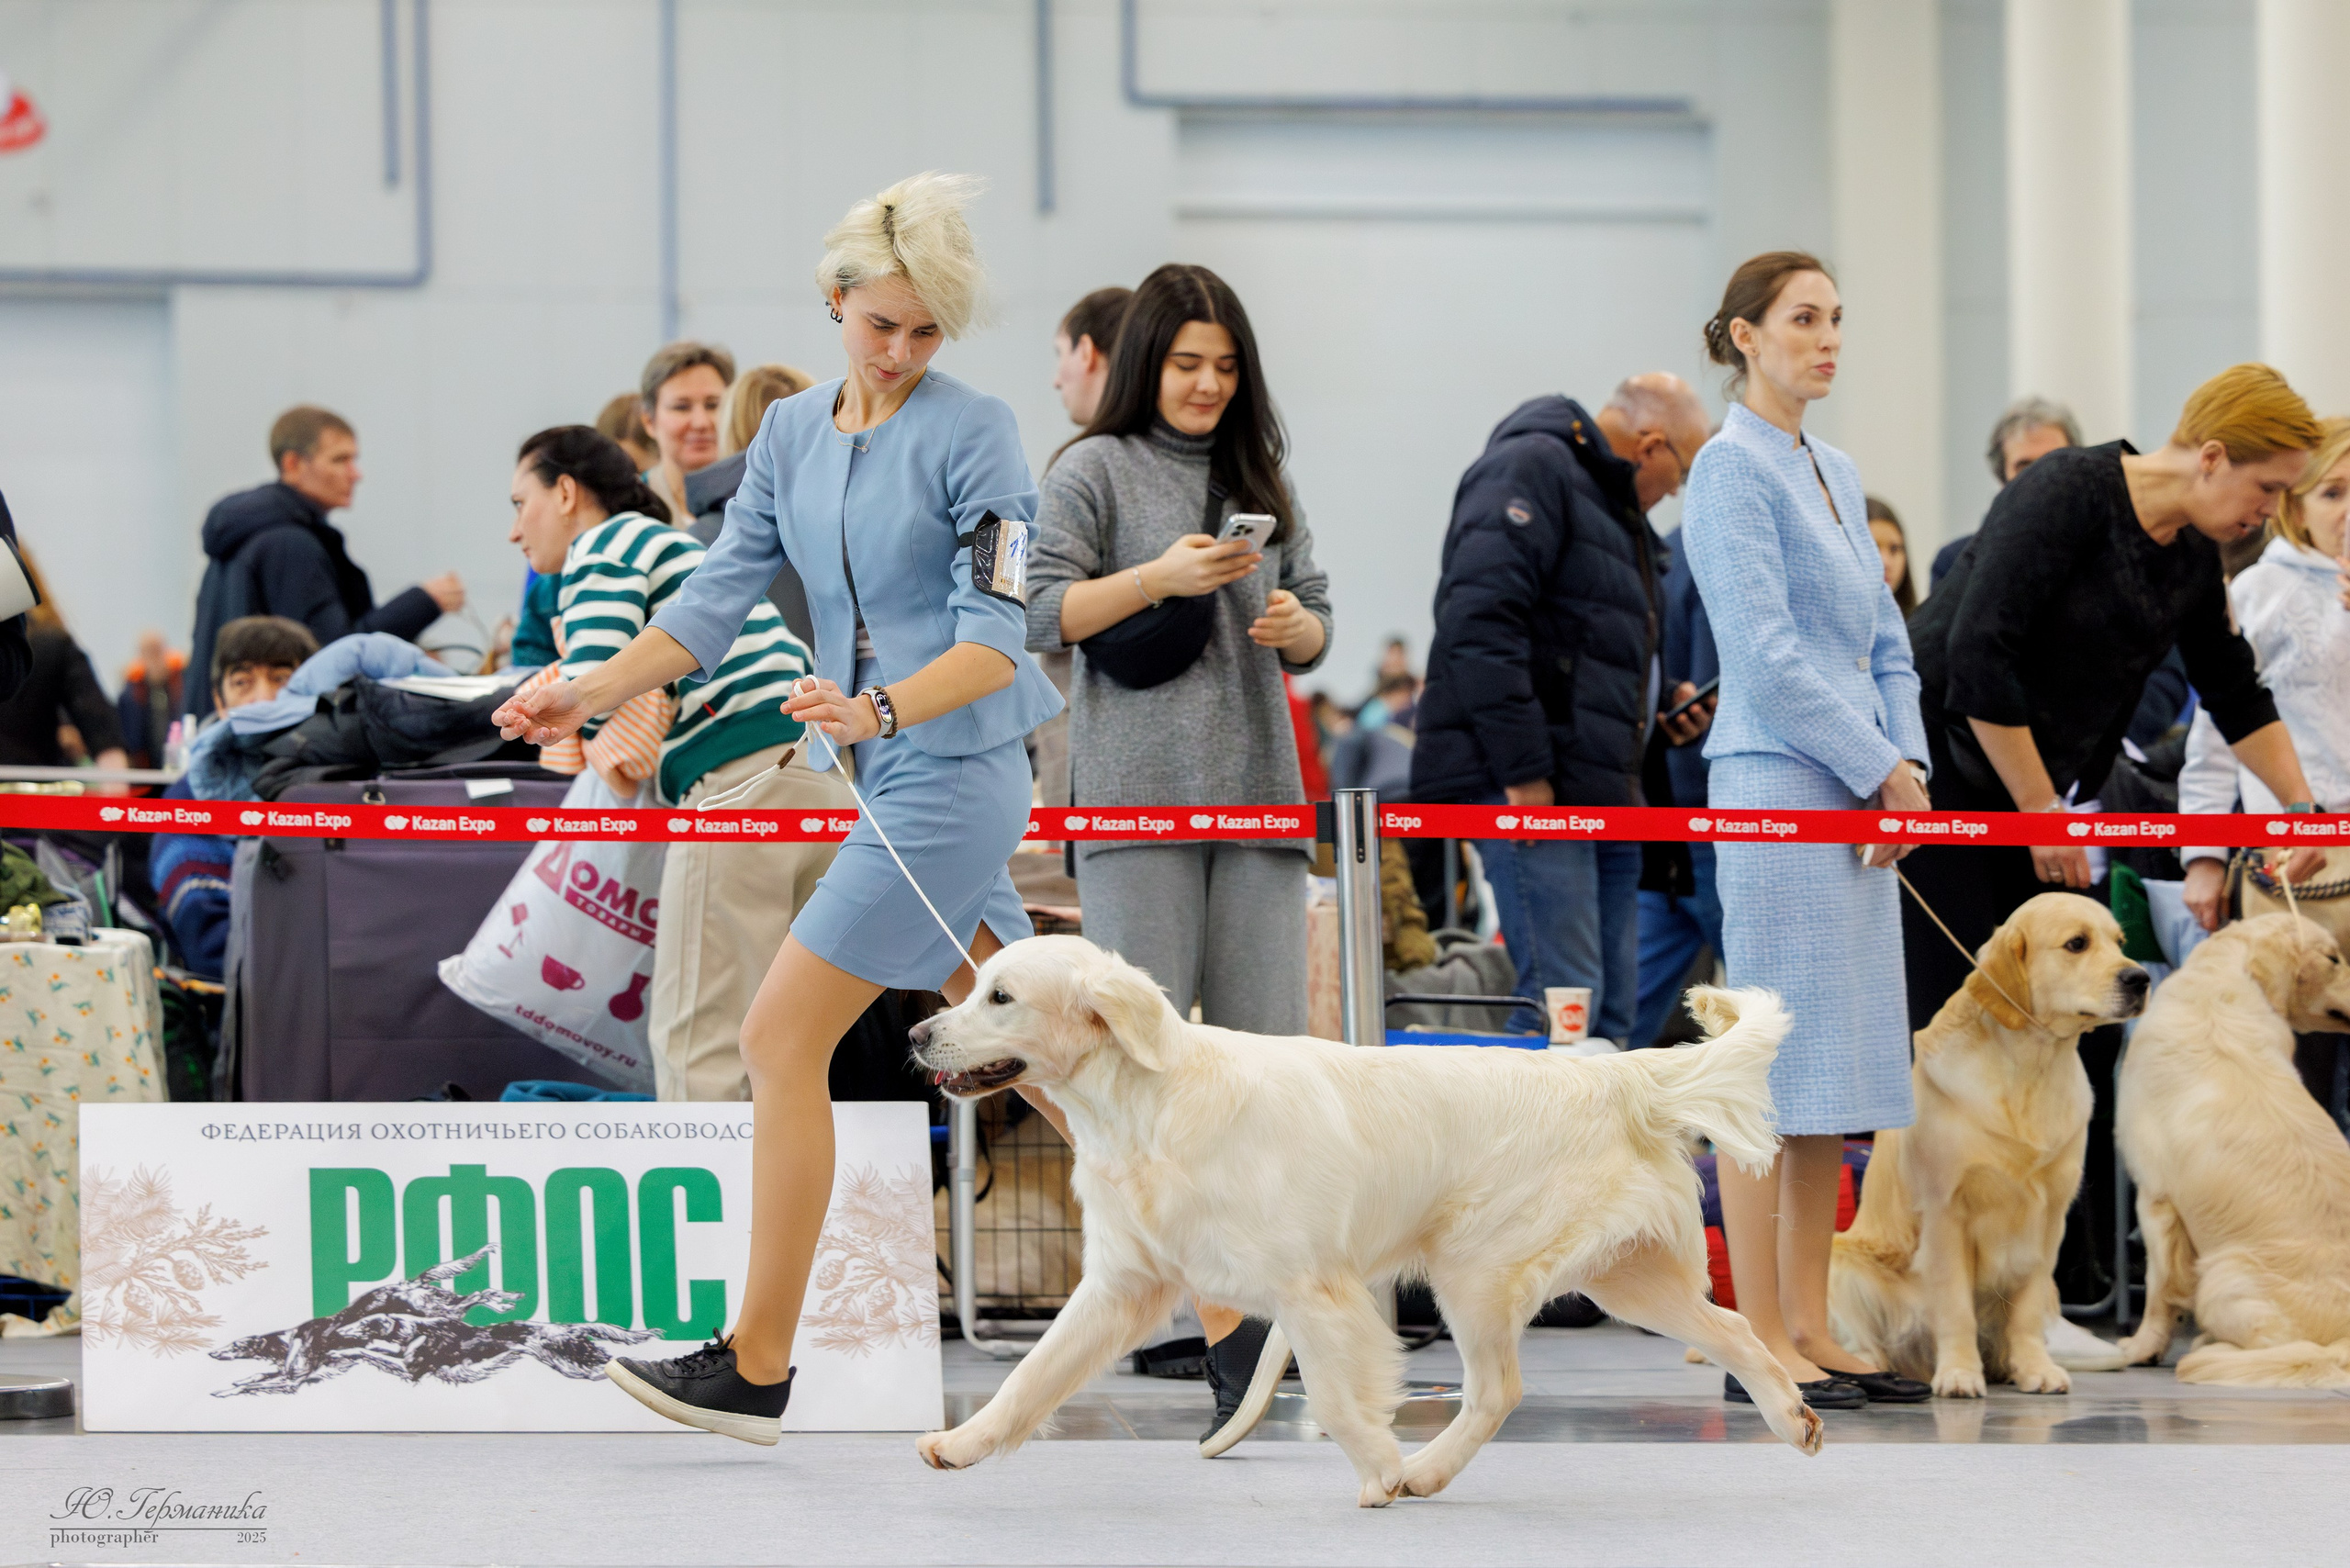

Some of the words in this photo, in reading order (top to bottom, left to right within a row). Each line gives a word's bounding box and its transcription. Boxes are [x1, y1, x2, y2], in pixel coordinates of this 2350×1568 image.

[127, 807, 173, 823] Kazan
[174, 808, 212, 826] Expo
[267, 811, 313, 827] Kazan
[314, 812, 352, 831] Expo
[411, 815, 457, 831] Kazan
[458, 815, 496, 835] Expo
[554, 817, 599, 833] Kazan
[599, 816, 638, 835] Expo
[1091, 815, 1136, 832] Kazan
[1137, 815, 1175, 834] Expo
[1216, 814, 1261, 830] Kazan
[1263, 813, 1300, 833] Expo
[1385, 812, 1422, 832] Expo
[1522, 814, 1566, 831] Kazan
[1568, 814, 1606, 834] Expo
[695, 818, 740, 834] Kazan
[741, 818, 778, 837] Expo
[1715, 818, 1760, 834] Kazan
[1761, 818, 1798, 838] Expo
[1906, 819, 1950, 834] Kazan
[1952, 819, 1988, 838] Expo
[2094, 822, 2138, 836] Kazan
[2139, 821, 2177, 839] Expo
[2292, 821, 2337, 835] Kazan
[515, 1004, 638, 1068] tddomovoy.ru
[201, 1122, 362, 1142] ФЕДЕРАЦИЯ
[371, 1122, 566, 1140] ОХОТНИЧЬЕГО
[308, 1164, 727, 1341] РФОС
